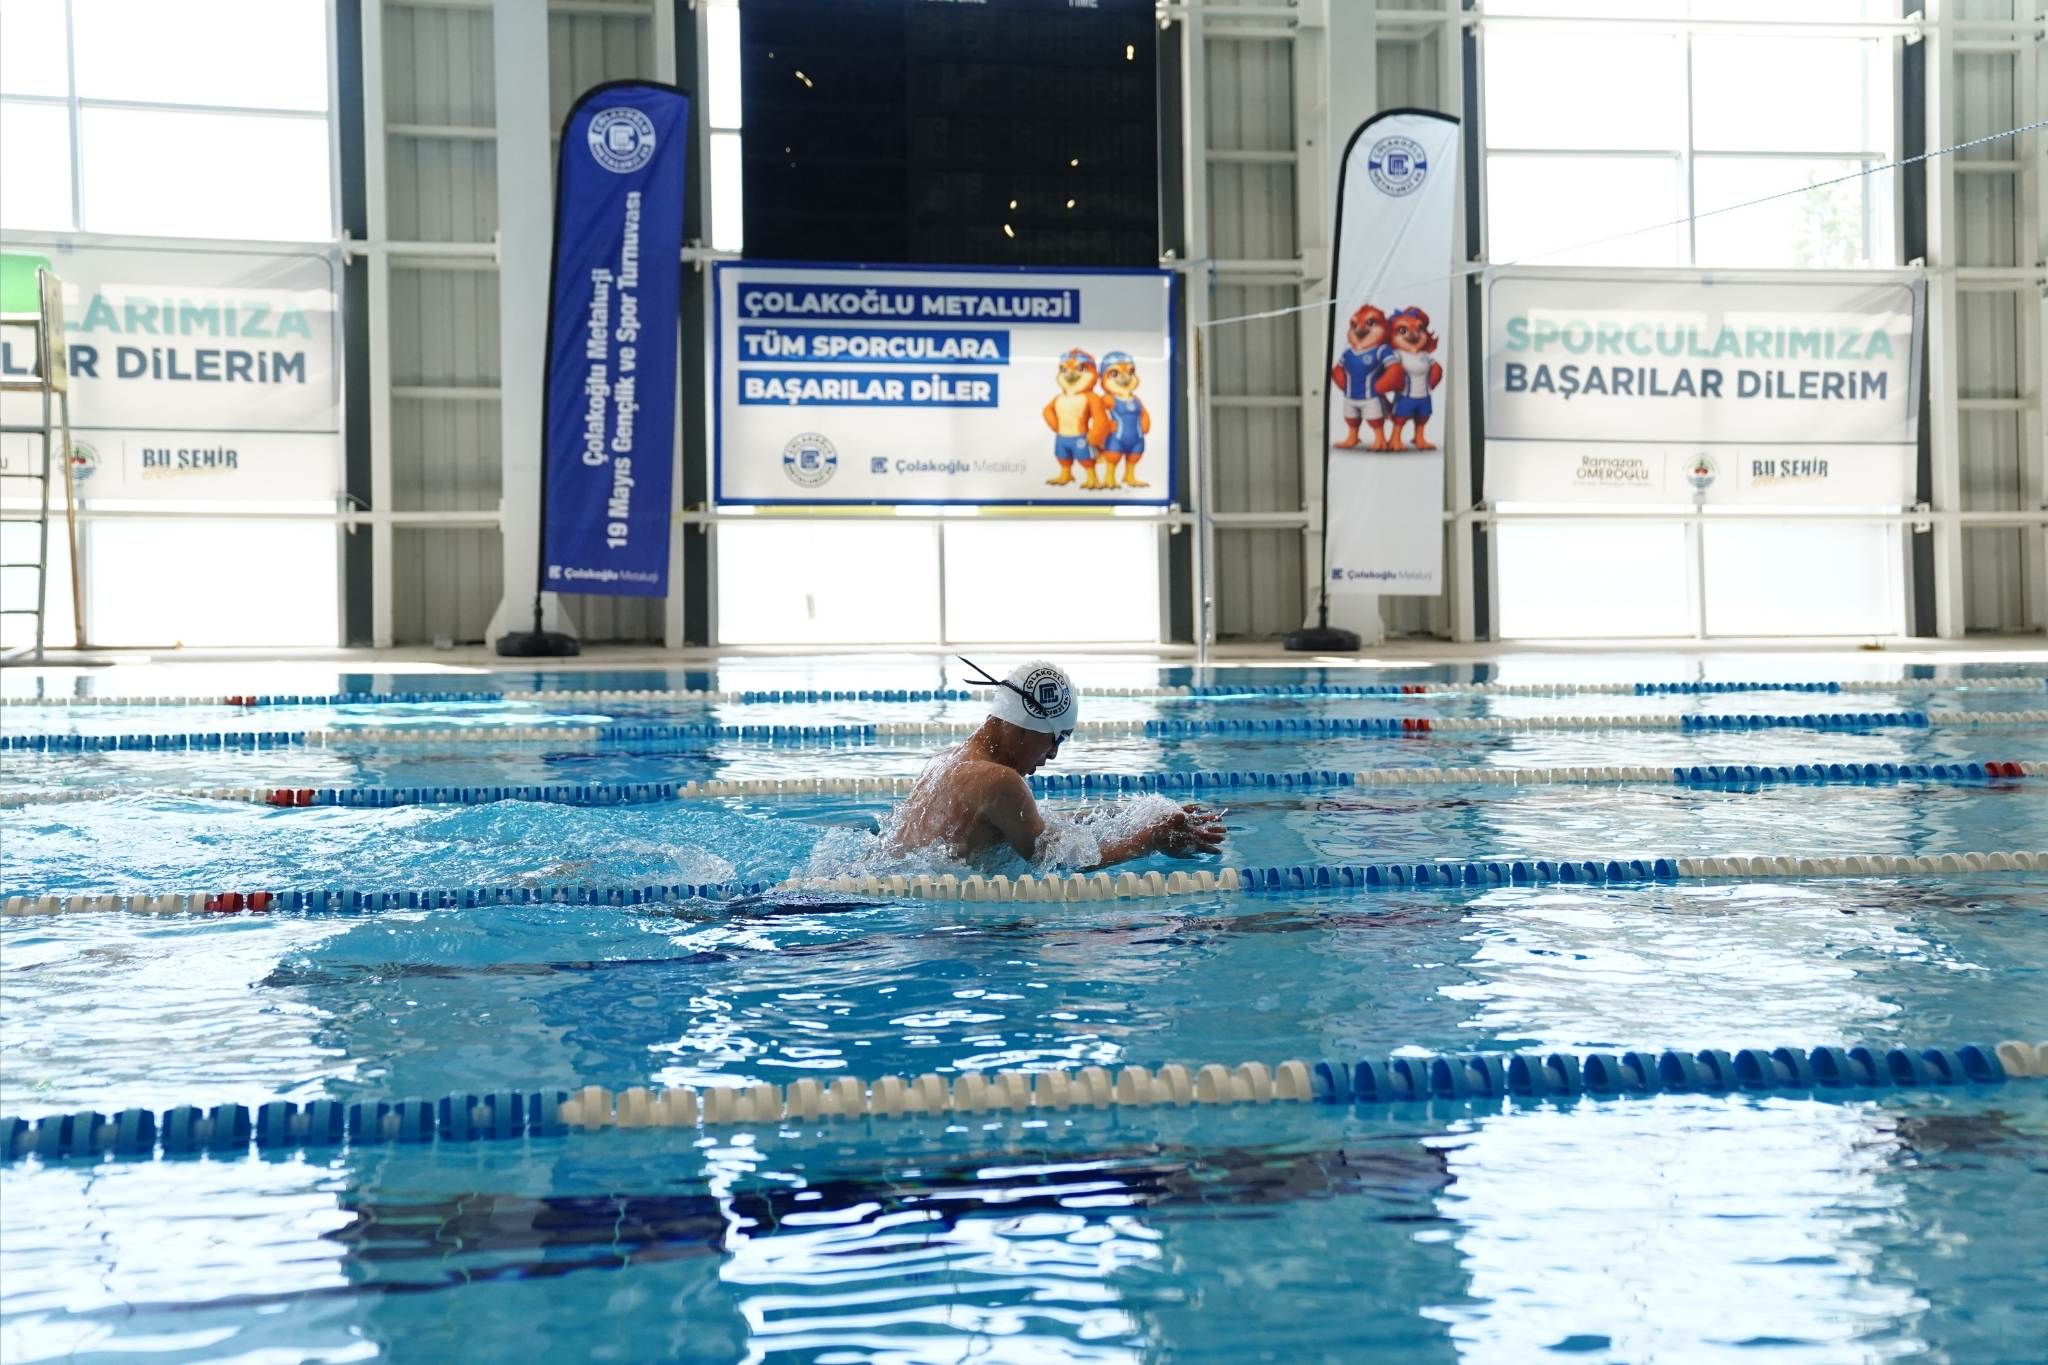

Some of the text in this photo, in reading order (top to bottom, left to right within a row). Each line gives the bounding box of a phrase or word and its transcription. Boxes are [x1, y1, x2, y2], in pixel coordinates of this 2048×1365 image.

[745, 289, 1072, 318] ÇOLAKOĞLU METALURJİ
[745, 331, 999, 359] TÜM SPORCULARA
[1505, 317, 1894, 360] SPORCULARIMIZA
[583, 267, 613, 466] Çolakoğlu Metalurji
[606, 191, 641, 549] 19 Mayıs Gençlik ve Spor Turnuvası
[1505, 363, 1724, 400] BAŞARILAR
[745, 374, 990, 404] BAŞARILAR DİLER
[895, 459, 970, 474] Çolakoğlu
[1582, 455, 1643, 467] Ramazan
